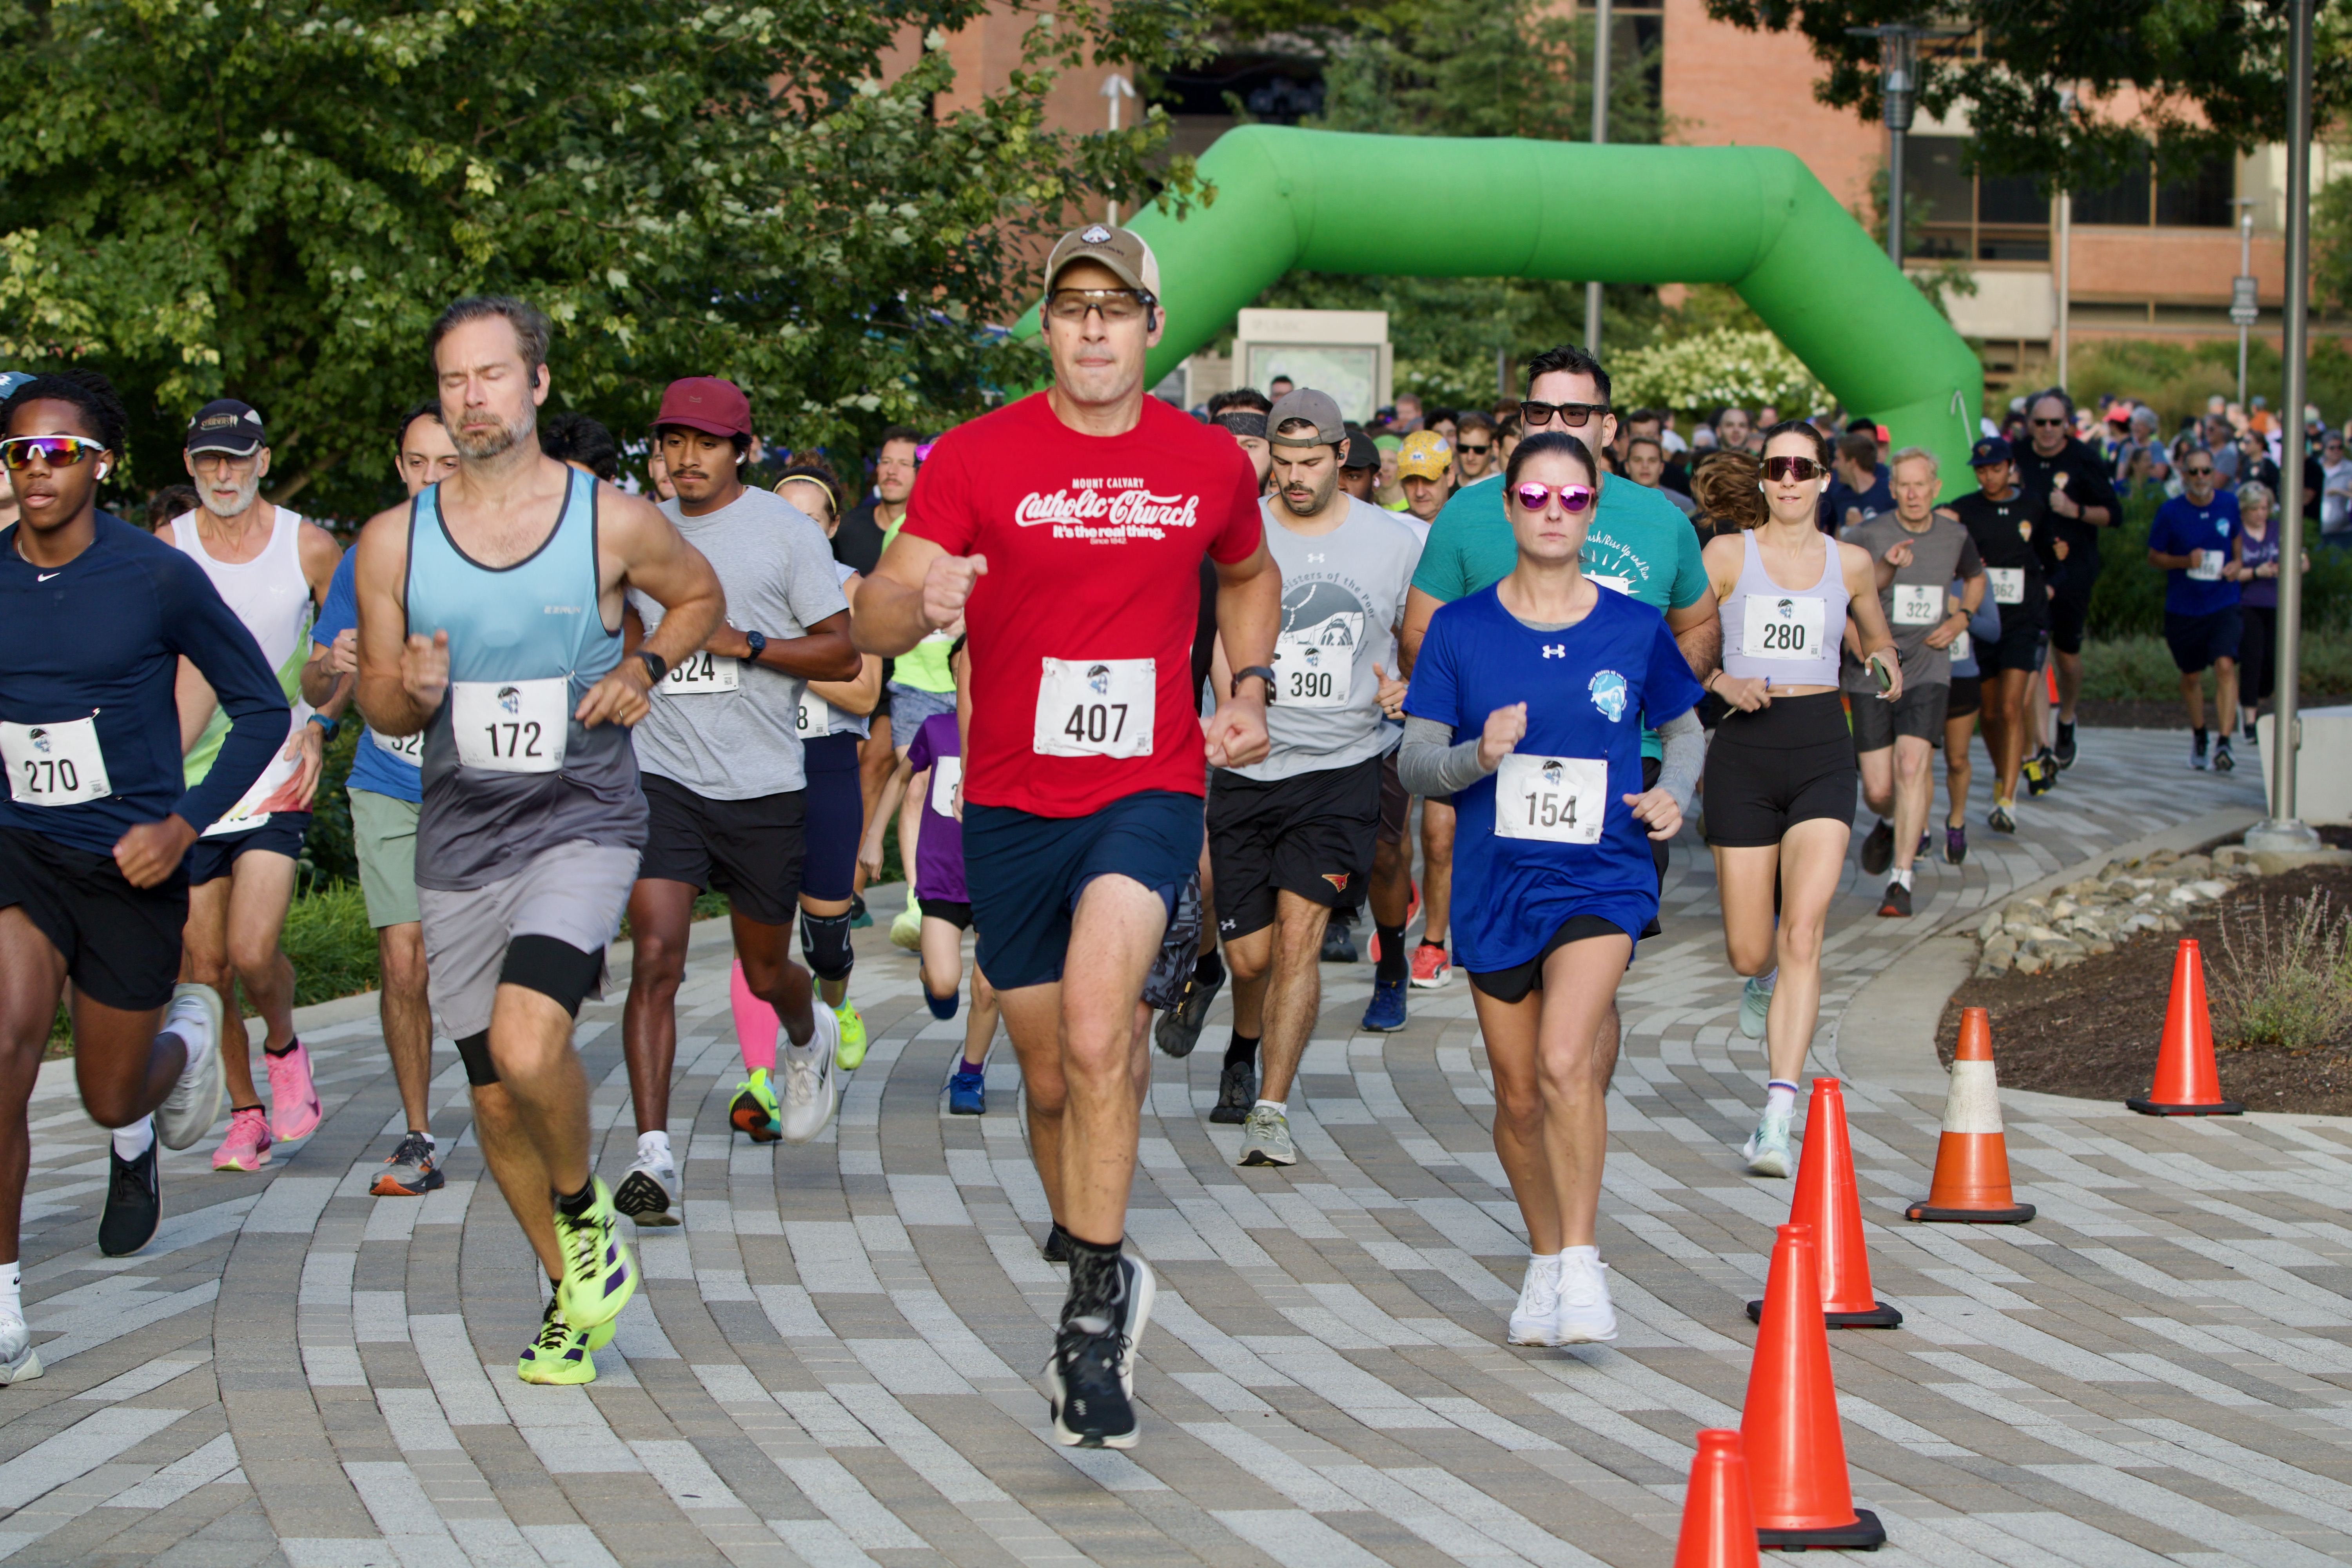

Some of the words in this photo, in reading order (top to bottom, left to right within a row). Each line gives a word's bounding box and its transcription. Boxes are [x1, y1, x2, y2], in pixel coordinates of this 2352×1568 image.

[1072, 477, 1103, 489] MOUNT
[1107, 477, 1144, 488] CALVARY
[1053, 524, 1074, 538] It's
[1074, 524, 1098, 538] the
[1098, 524, 1126, 538] real
[1126, 524, 1166, 540] thing.
[1586, 530, 1621, 549] ash/Rise
[1619, 544, 1631, 559] Up
[1630, 555, 1647, 568] and
[1639, 565, 1649, 581] Run
[1282, 572, 1322, 592] Sisters
[1327, 572, 1340, 583] of
[1344, 577, 1361, 593] the
[1361, 593, 1374, 619] Poor
[1906, 602, 1931, 618] 322
[1764, 624, 1804, 650] 280
[1291, 673, 1331, 697] 390
[486, 722, 541, 757] 172
[1065, 704, 1127, 742] 407
[25, 759, 78, 793] 270
[1526, 792, 1577, 828] 154
